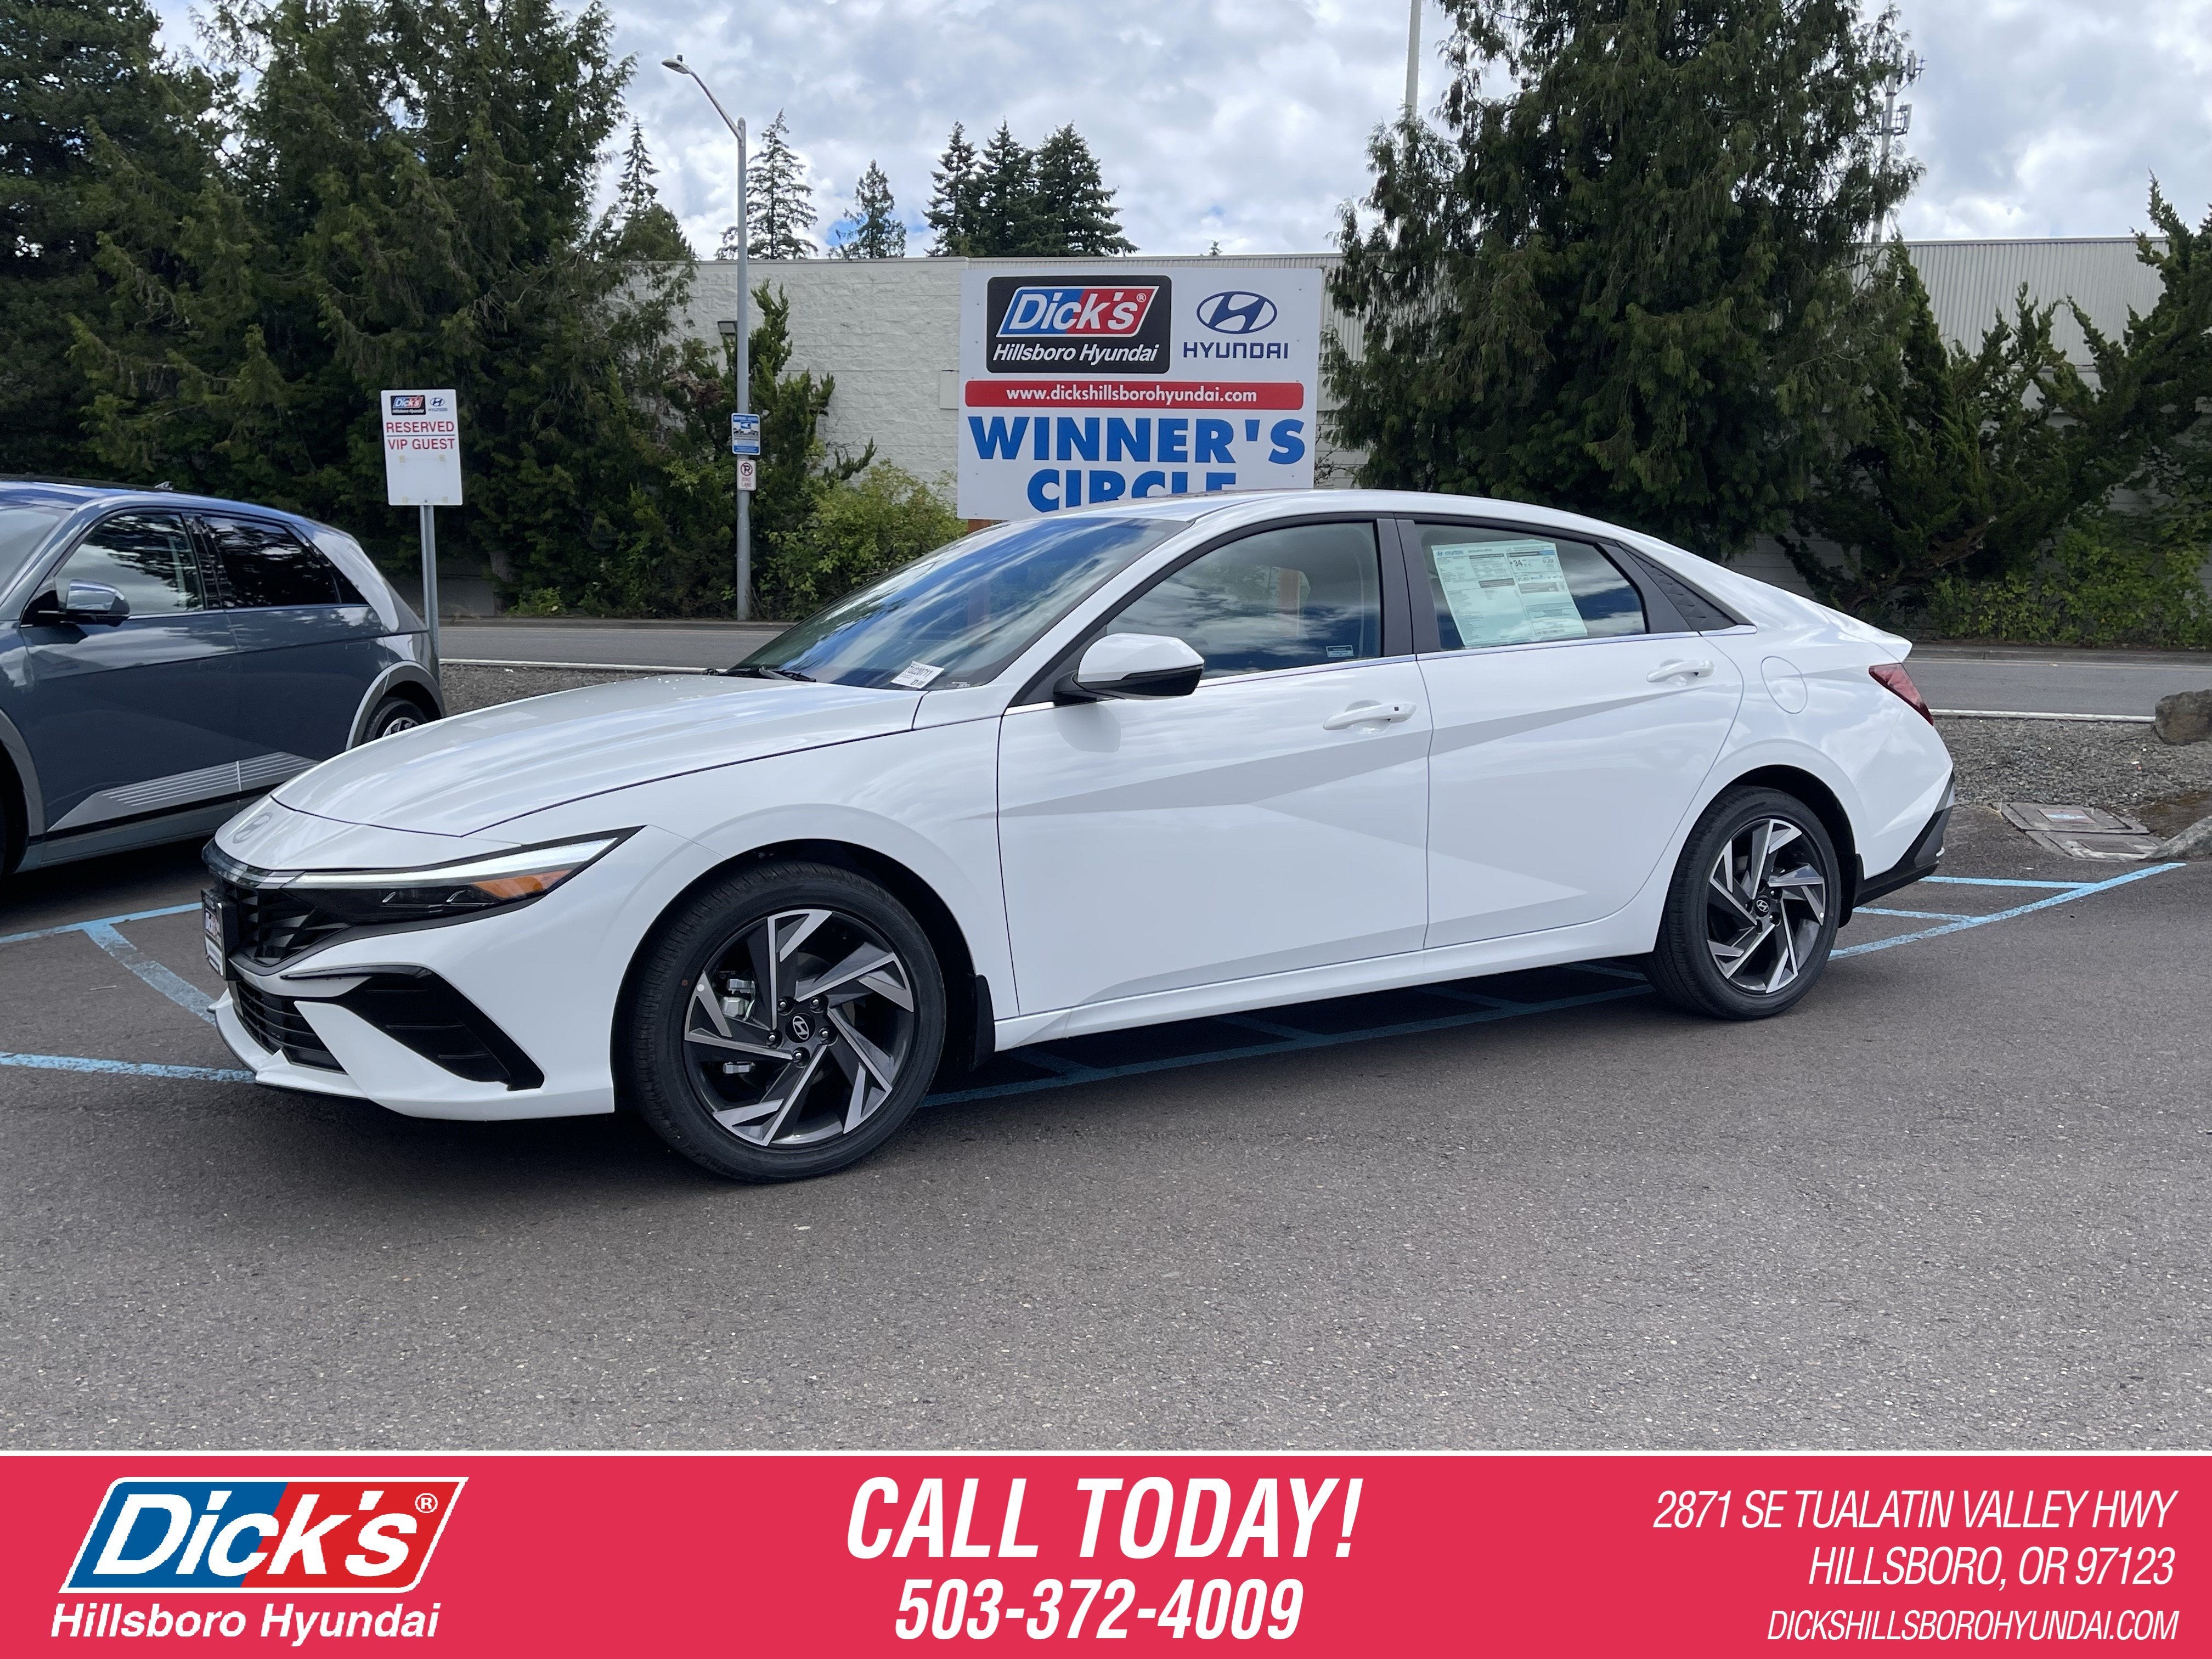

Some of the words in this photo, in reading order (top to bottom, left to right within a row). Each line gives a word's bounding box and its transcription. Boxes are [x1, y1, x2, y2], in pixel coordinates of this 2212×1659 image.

[1008, 292, 1138, 330] Dick's
[992, 343, 1076, 362] Hillsboro
[1078, 343, 1160, 366] Hyundai
[1183, 341, 1289, 359] HYUNDAI
[1006, 384, 1257, 405] www.dickshillsborohyundai.com
[386, 421, 455, 433] RESERVED
[388, 439, 408, 450] VIP
[412, 438, 455, 449] GUEST
[967, 416, 1305, 465] WINNER'S
